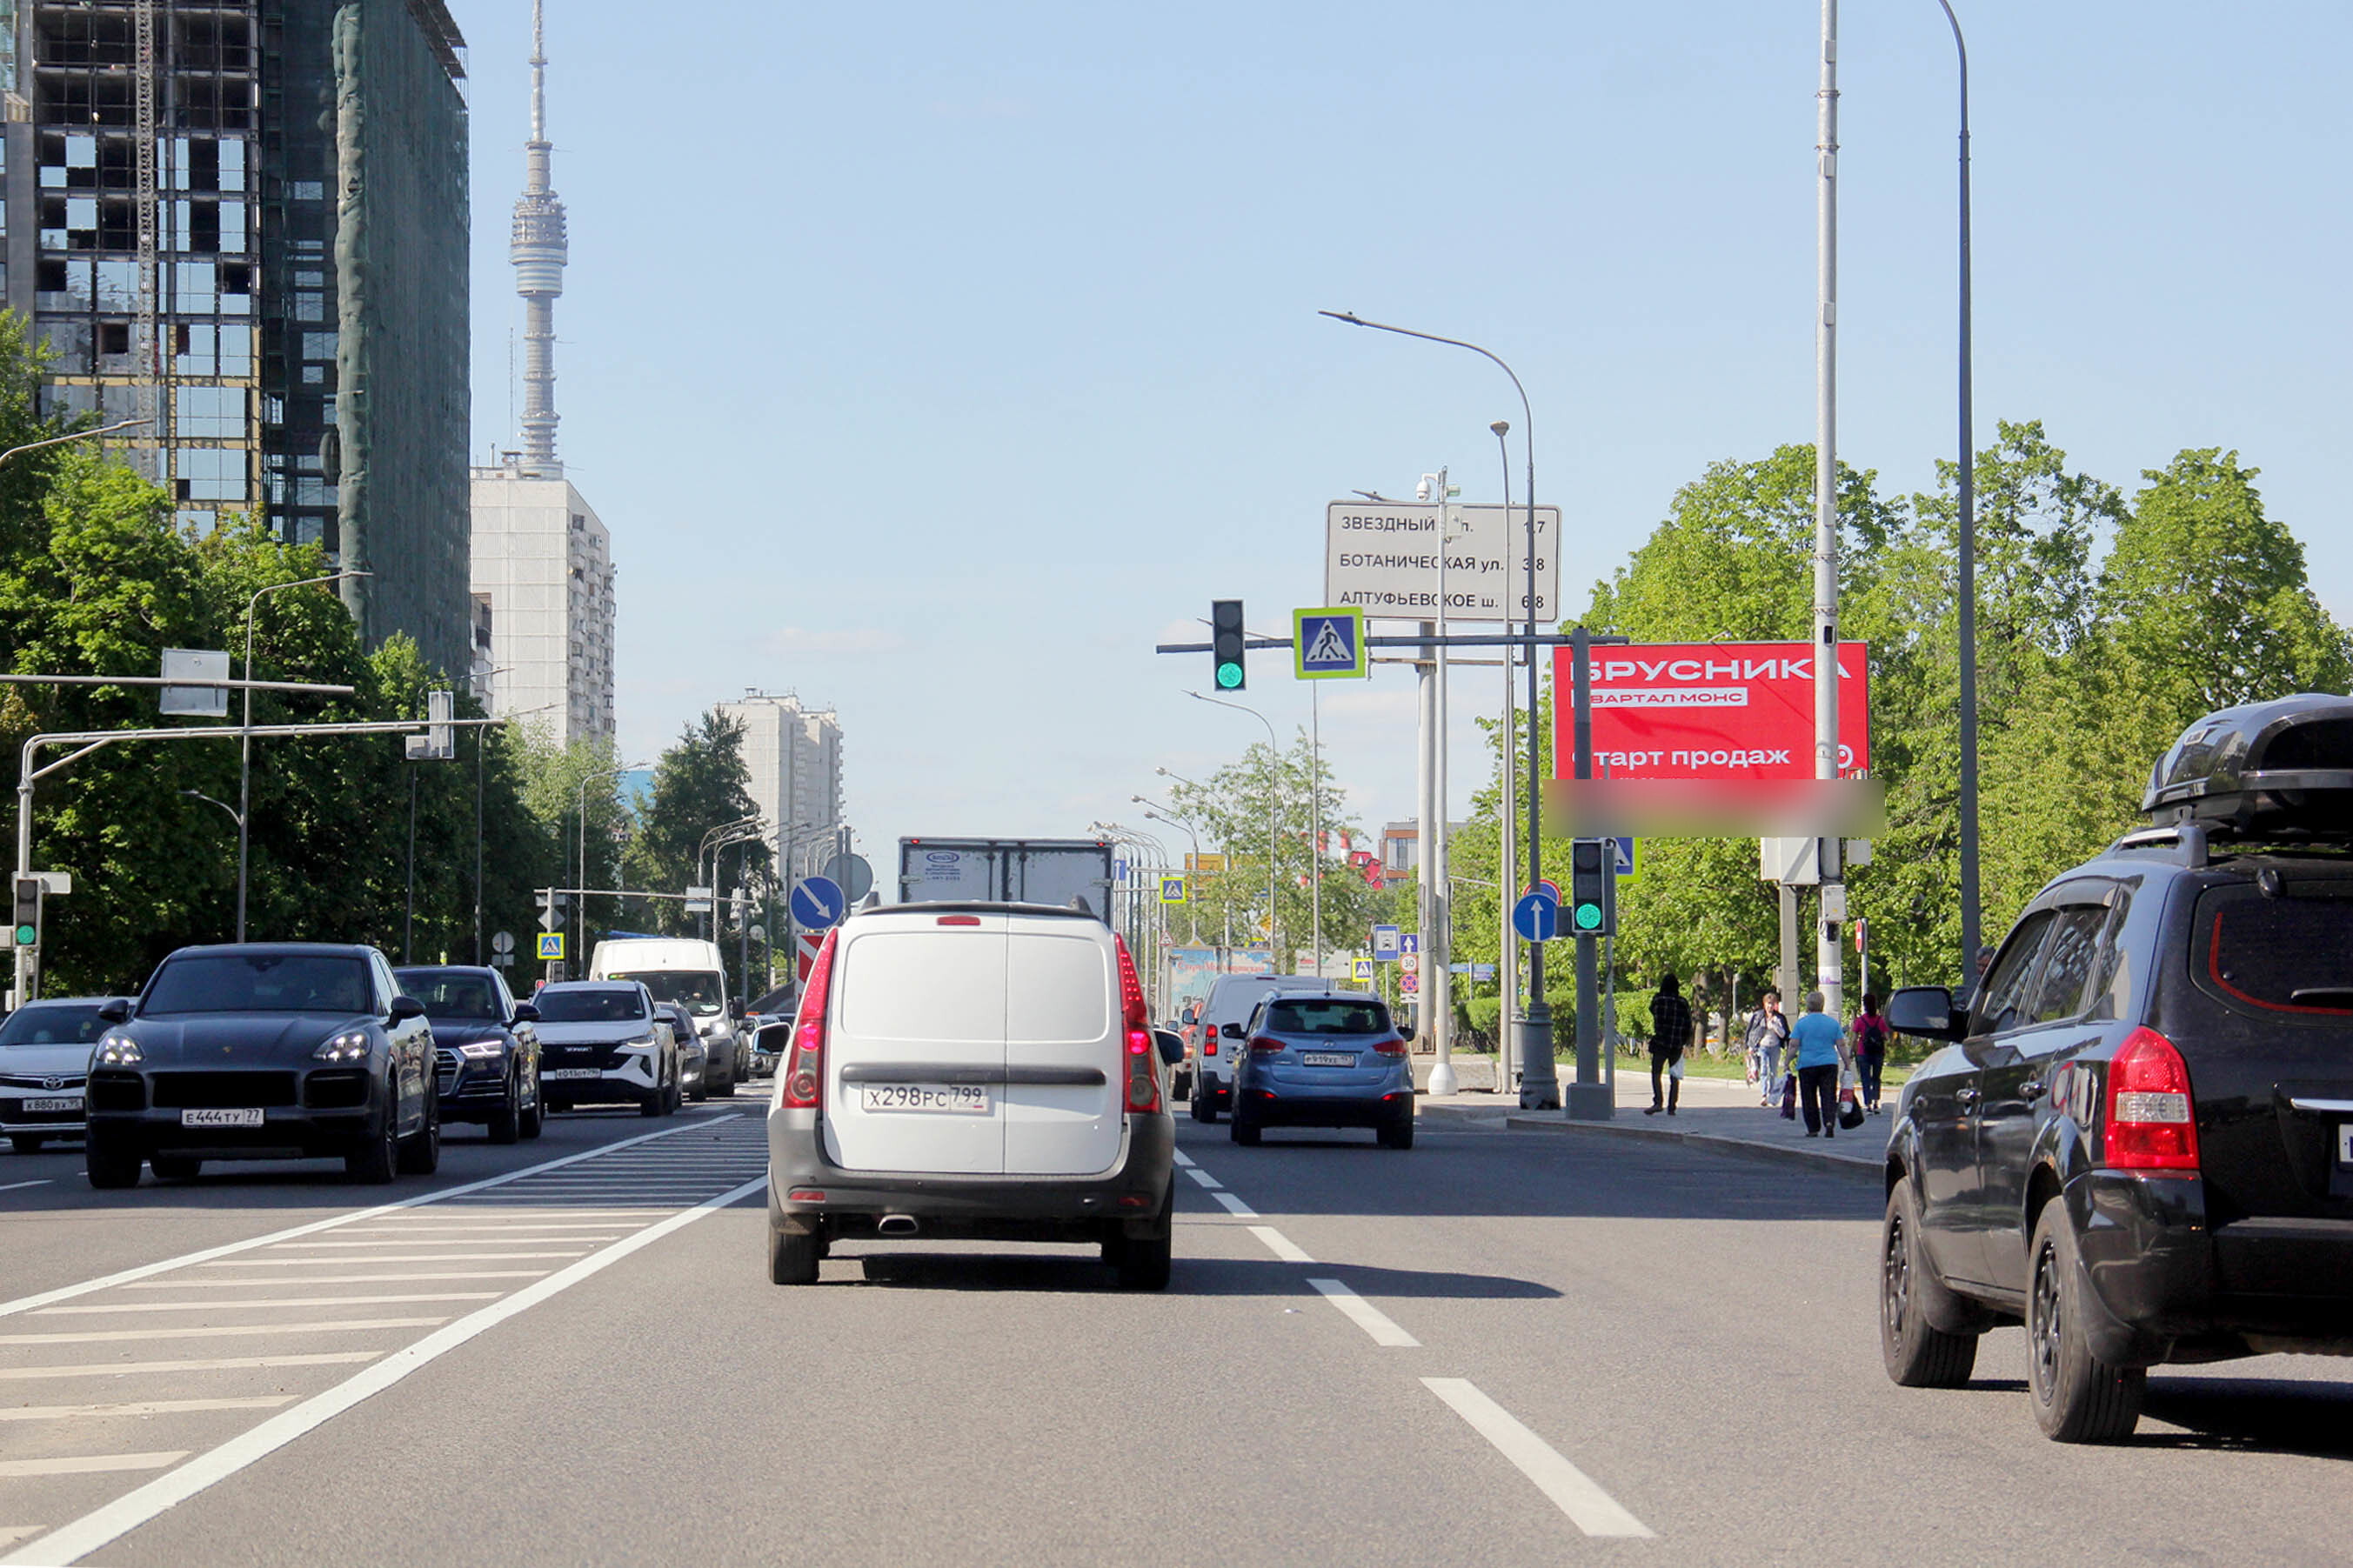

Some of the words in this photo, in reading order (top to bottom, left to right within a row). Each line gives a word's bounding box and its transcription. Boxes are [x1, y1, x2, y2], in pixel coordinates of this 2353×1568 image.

[1341, 516, 1435, 532] ЗВЕЗДНЫЙ
[1340, 553, 1475, 570] БОТАНИЧЕСКАЯ
[1481, 559, 1504, 573] ул.
[1522, 558, 1545, 570] 38
[1340, 591, 1475, 607] АЛТУФЬЕВСКОЕ
[1481, 598, 1499, 607] ш.
[1521, 596, 1544, 608] 68
[1591, 694, 1675, 704] ВАРТАЛ
[1680, 693, 1742, 703] МОНС
[1572, 750, 1664, 771] тарт
[1671, 749, 1790, 770] продаж
[1403, 959, 1414, 968] 30
[870, 1087, 946, 1106] Х298РС
[952, 1087, 982, 1102] 799
